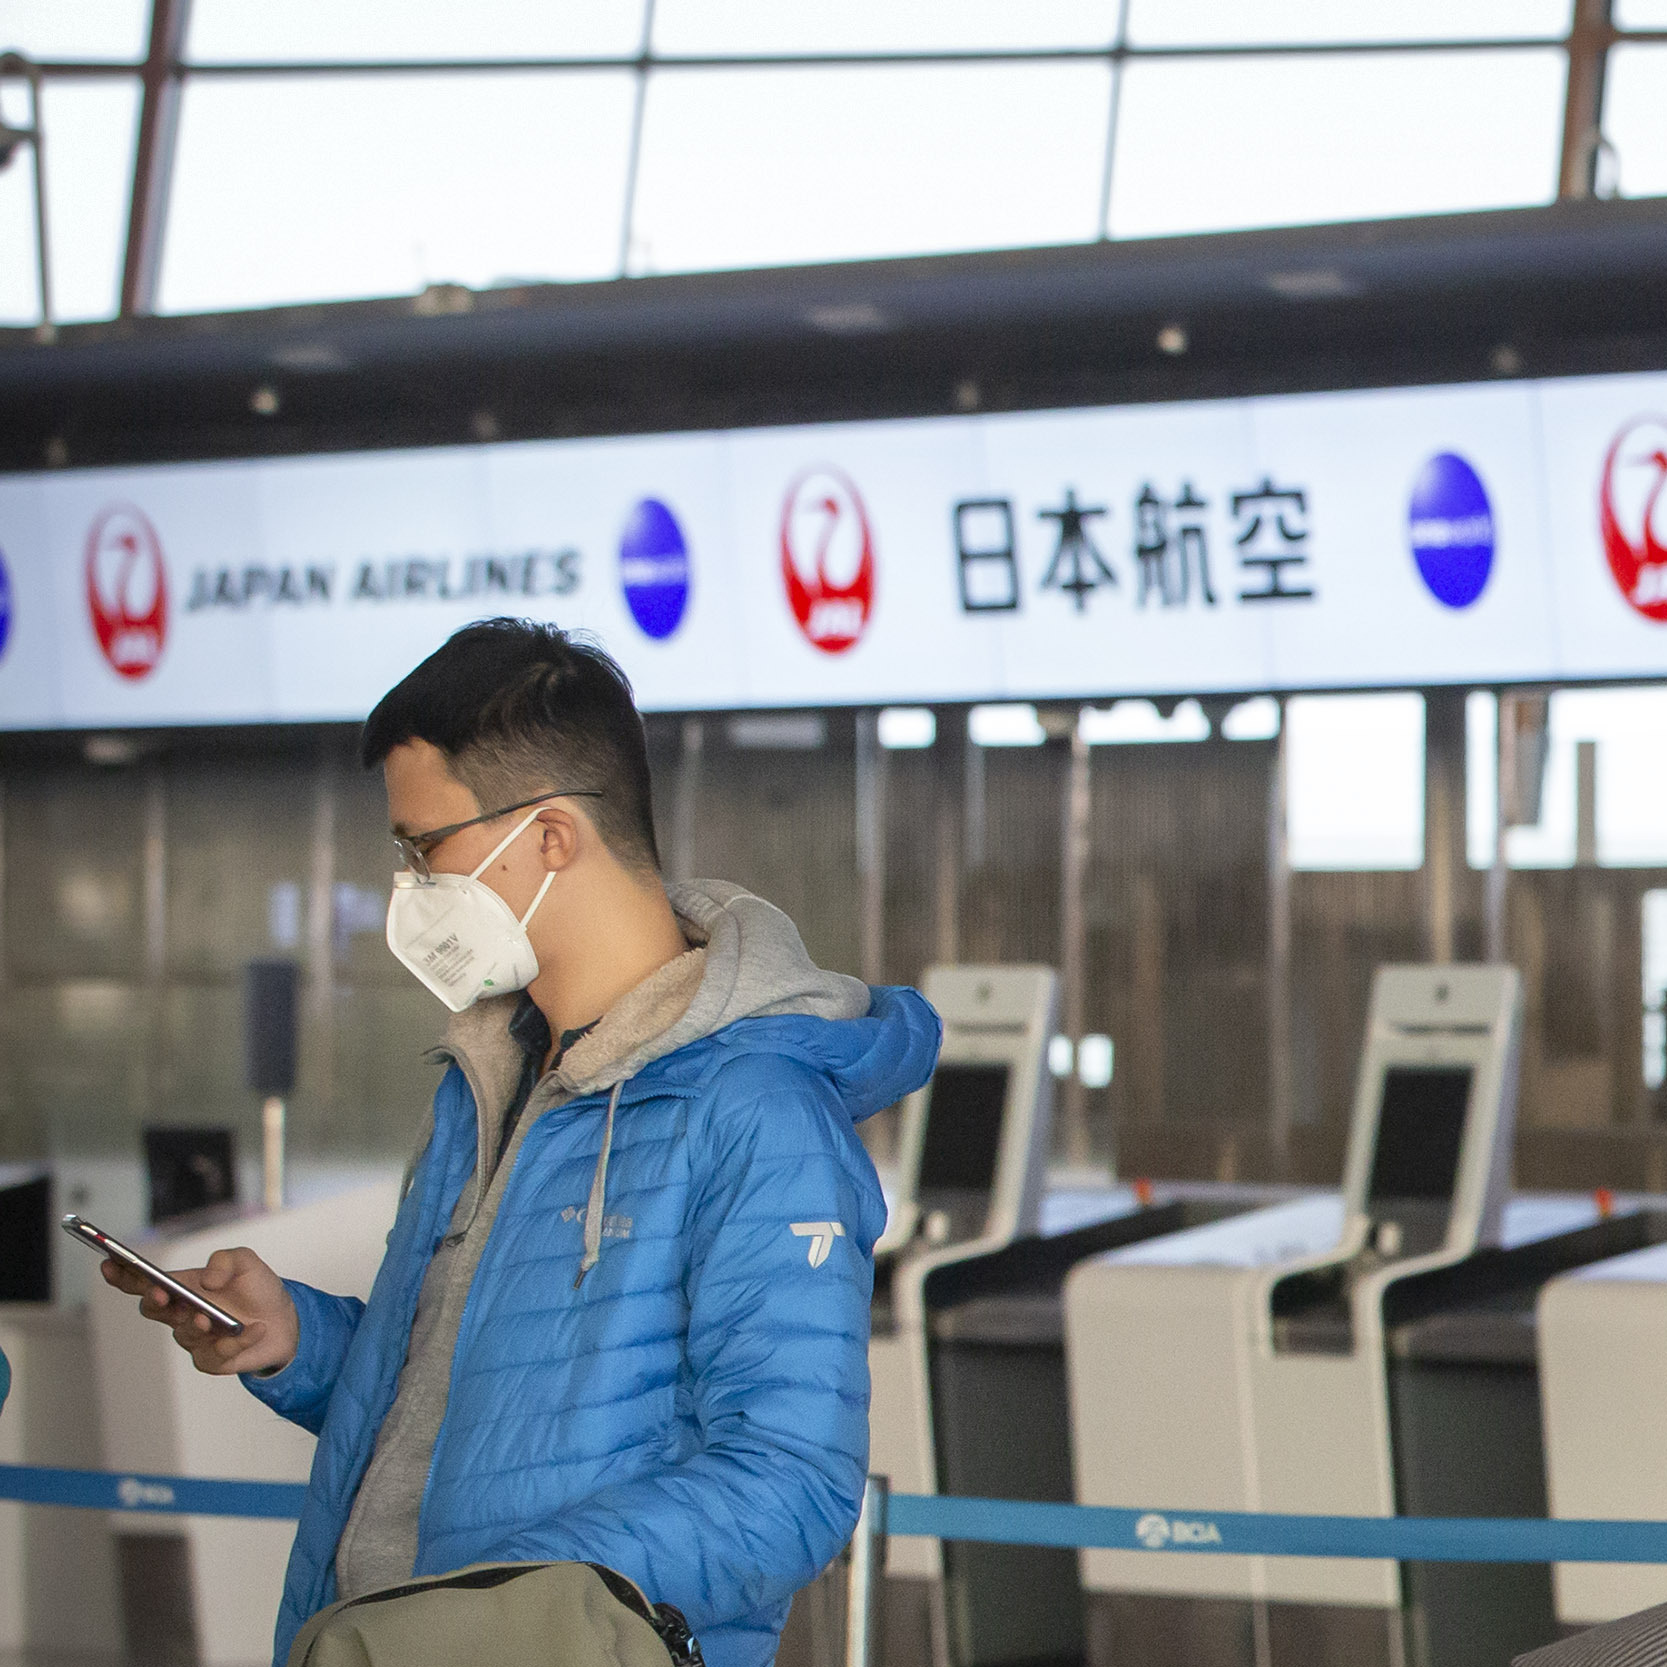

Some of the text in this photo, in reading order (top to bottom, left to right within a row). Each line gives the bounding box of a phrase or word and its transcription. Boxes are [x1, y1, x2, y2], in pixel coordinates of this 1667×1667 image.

[181, 563, 336, 614] JAPAN
[349, 546, 586, 602] AIRLINES
[953, 474, 1318, 616] 日本航空
